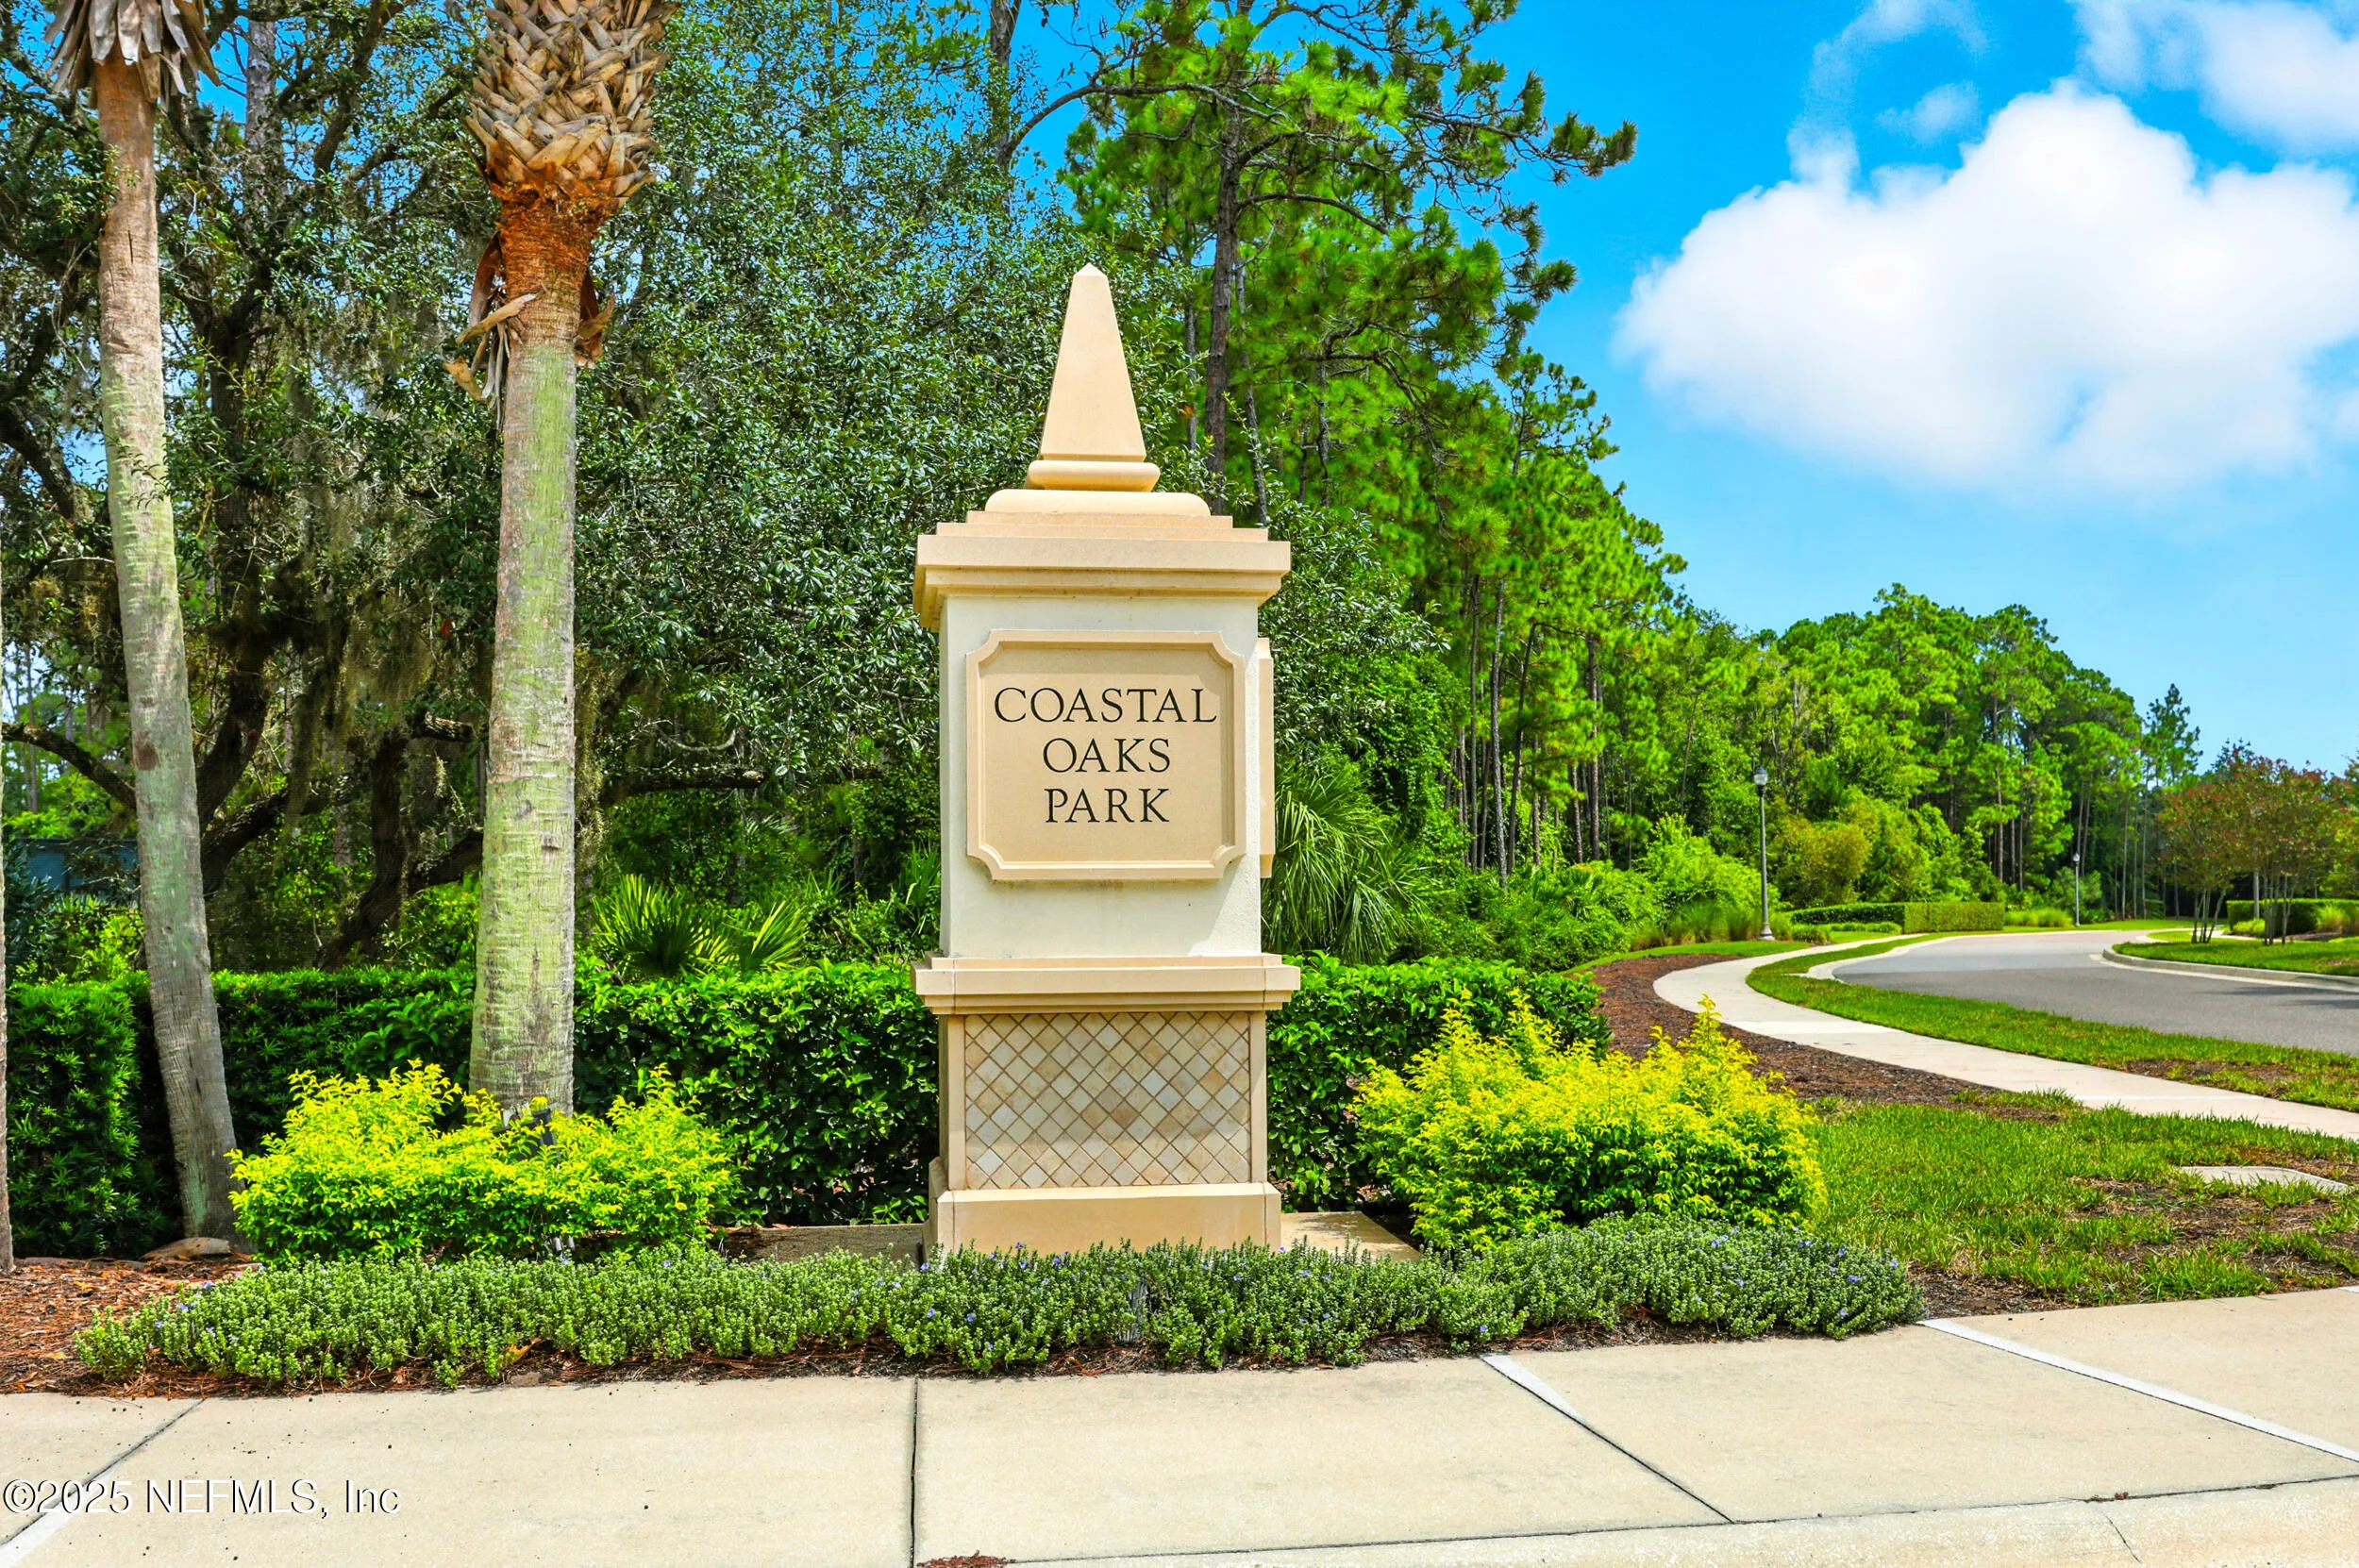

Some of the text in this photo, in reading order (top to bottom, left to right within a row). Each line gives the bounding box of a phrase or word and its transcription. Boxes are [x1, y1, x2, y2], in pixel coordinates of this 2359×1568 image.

[994, 687, 1217, 723] COASTAL
[1042, 738, 1171, 773] OAKS
[1044, 788, 1170, 824] PARK
